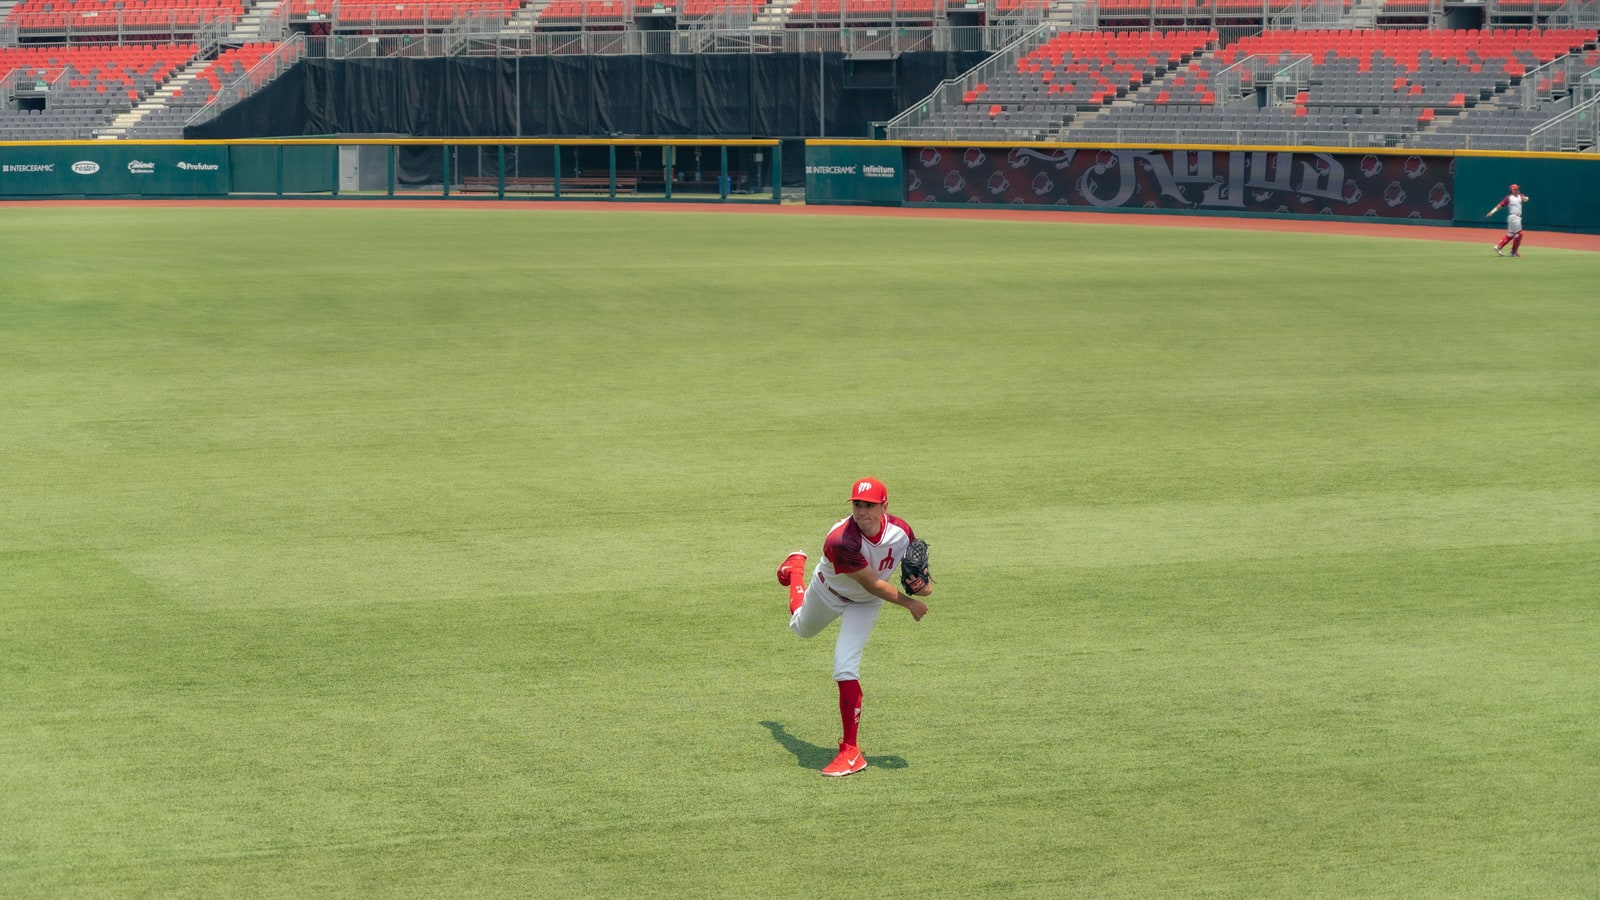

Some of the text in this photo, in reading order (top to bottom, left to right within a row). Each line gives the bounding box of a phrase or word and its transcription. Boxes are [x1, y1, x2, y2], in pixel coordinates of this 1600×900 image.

[9, 164, 54, 172] INTERCERAMIC
[186, 162, 219, 171] Profuturo
[812, 166, 857, 174] INTERCERAMIC
